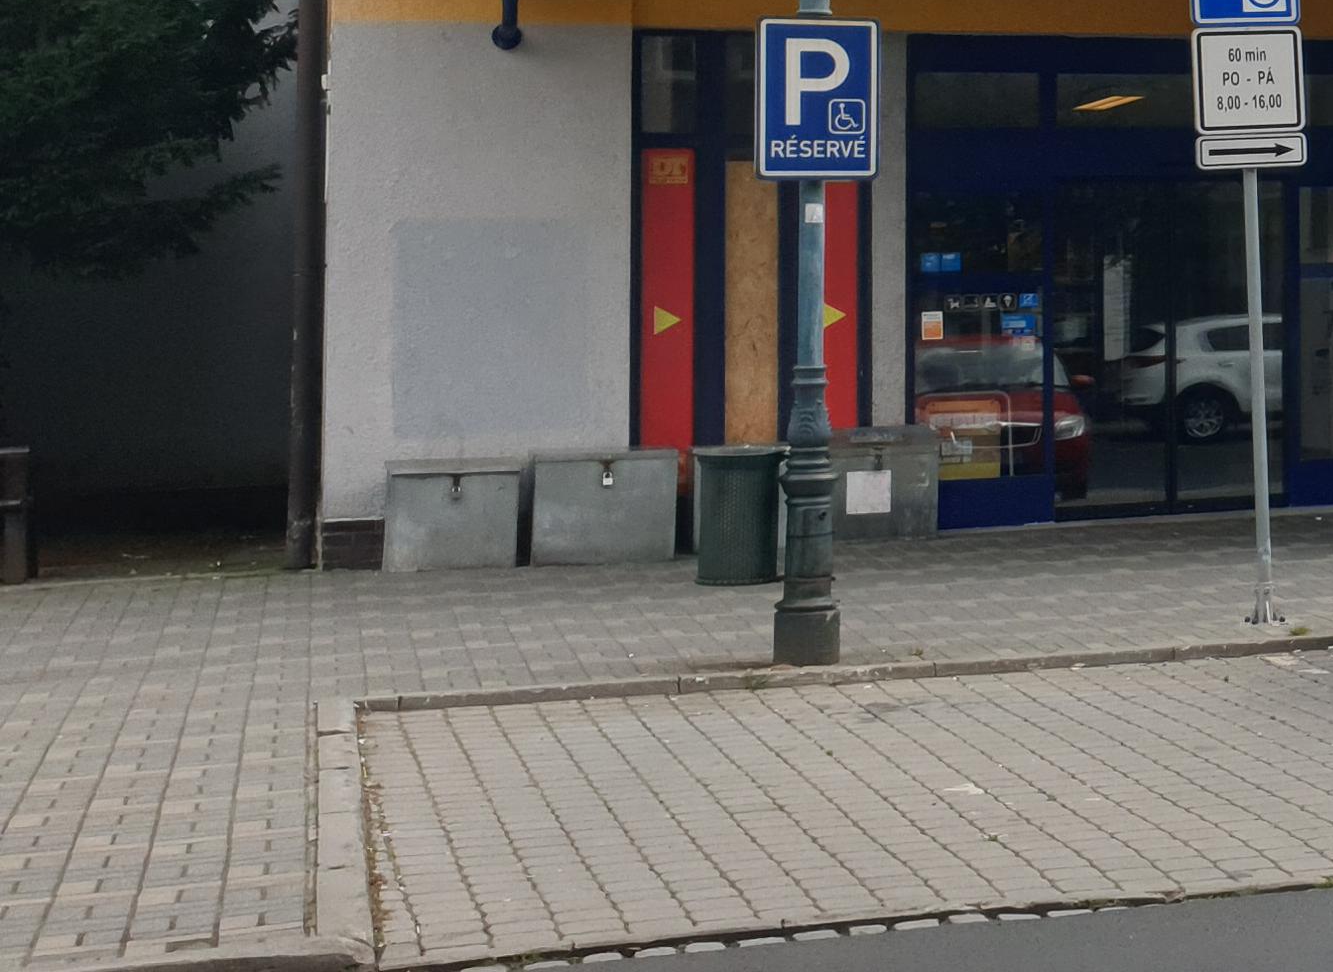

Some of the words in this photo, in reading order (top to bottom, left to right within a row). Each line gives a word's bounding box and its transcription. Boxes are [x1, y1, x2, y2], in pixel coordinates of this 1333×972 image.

[1228, 48, 1242, 62] 60
[1245, 47, 1267, 62] min
[785, 38, 850, 125] P
[1222, 71, 1240, 86] PO
[1257, 67, 1275, 85] PÁ
[770, 134, 866, 158] RÉSERVÉ
